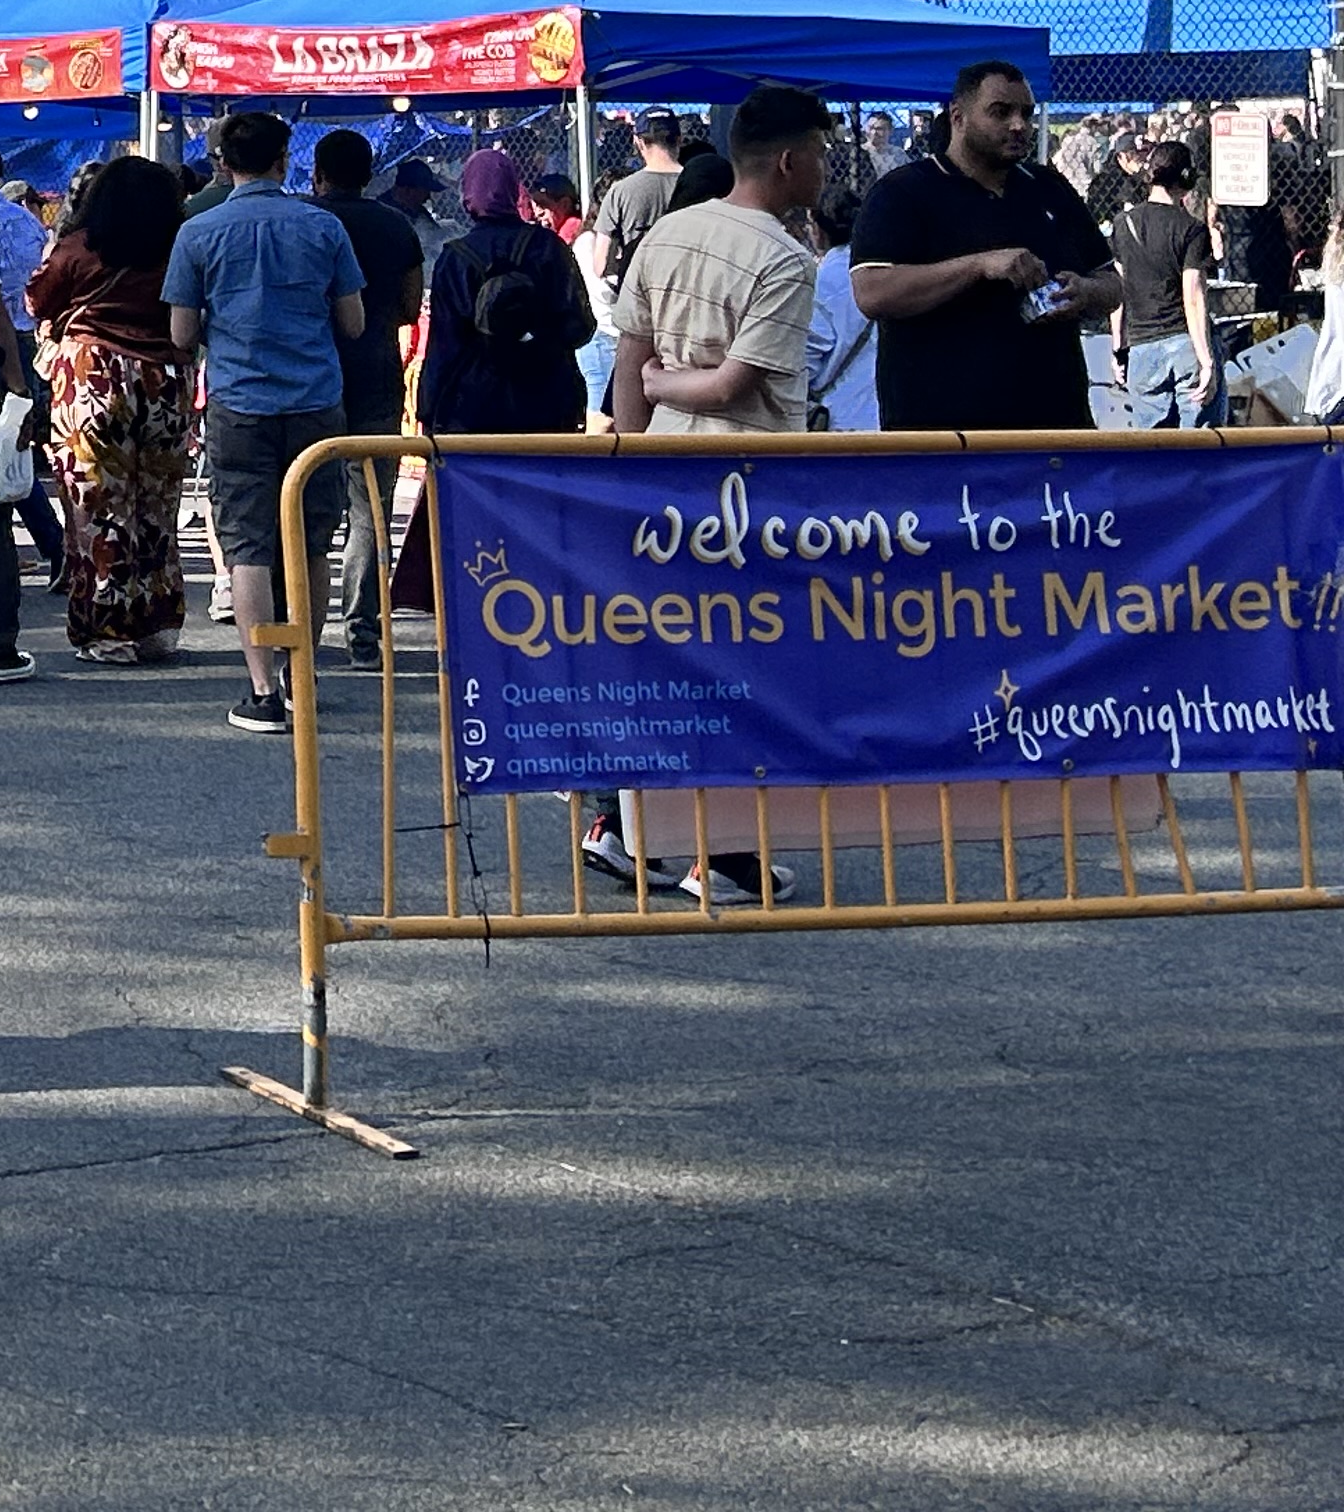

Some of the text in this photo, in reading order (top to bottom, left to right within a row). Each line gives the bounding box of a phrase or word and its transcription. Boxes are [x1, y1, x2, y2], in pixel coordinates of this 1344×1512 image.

[268, 34, 316, 74] LA
[316, 31, 435, 74] BRAZA
[462, 44, 515, 61] THE COB
[632, 471, 1121, 570] welcome to the
[482, 579, 785, 659] Queens
[809, 571, 1023, 659] Night
[502, 680, 752, 707] Queens Night Market
[504, 714, 732, 742] queensnightmarket
[968, 684, 1336, 769] #queensnightmarket
[506, 751, 692, 778] qnsnightmarket
